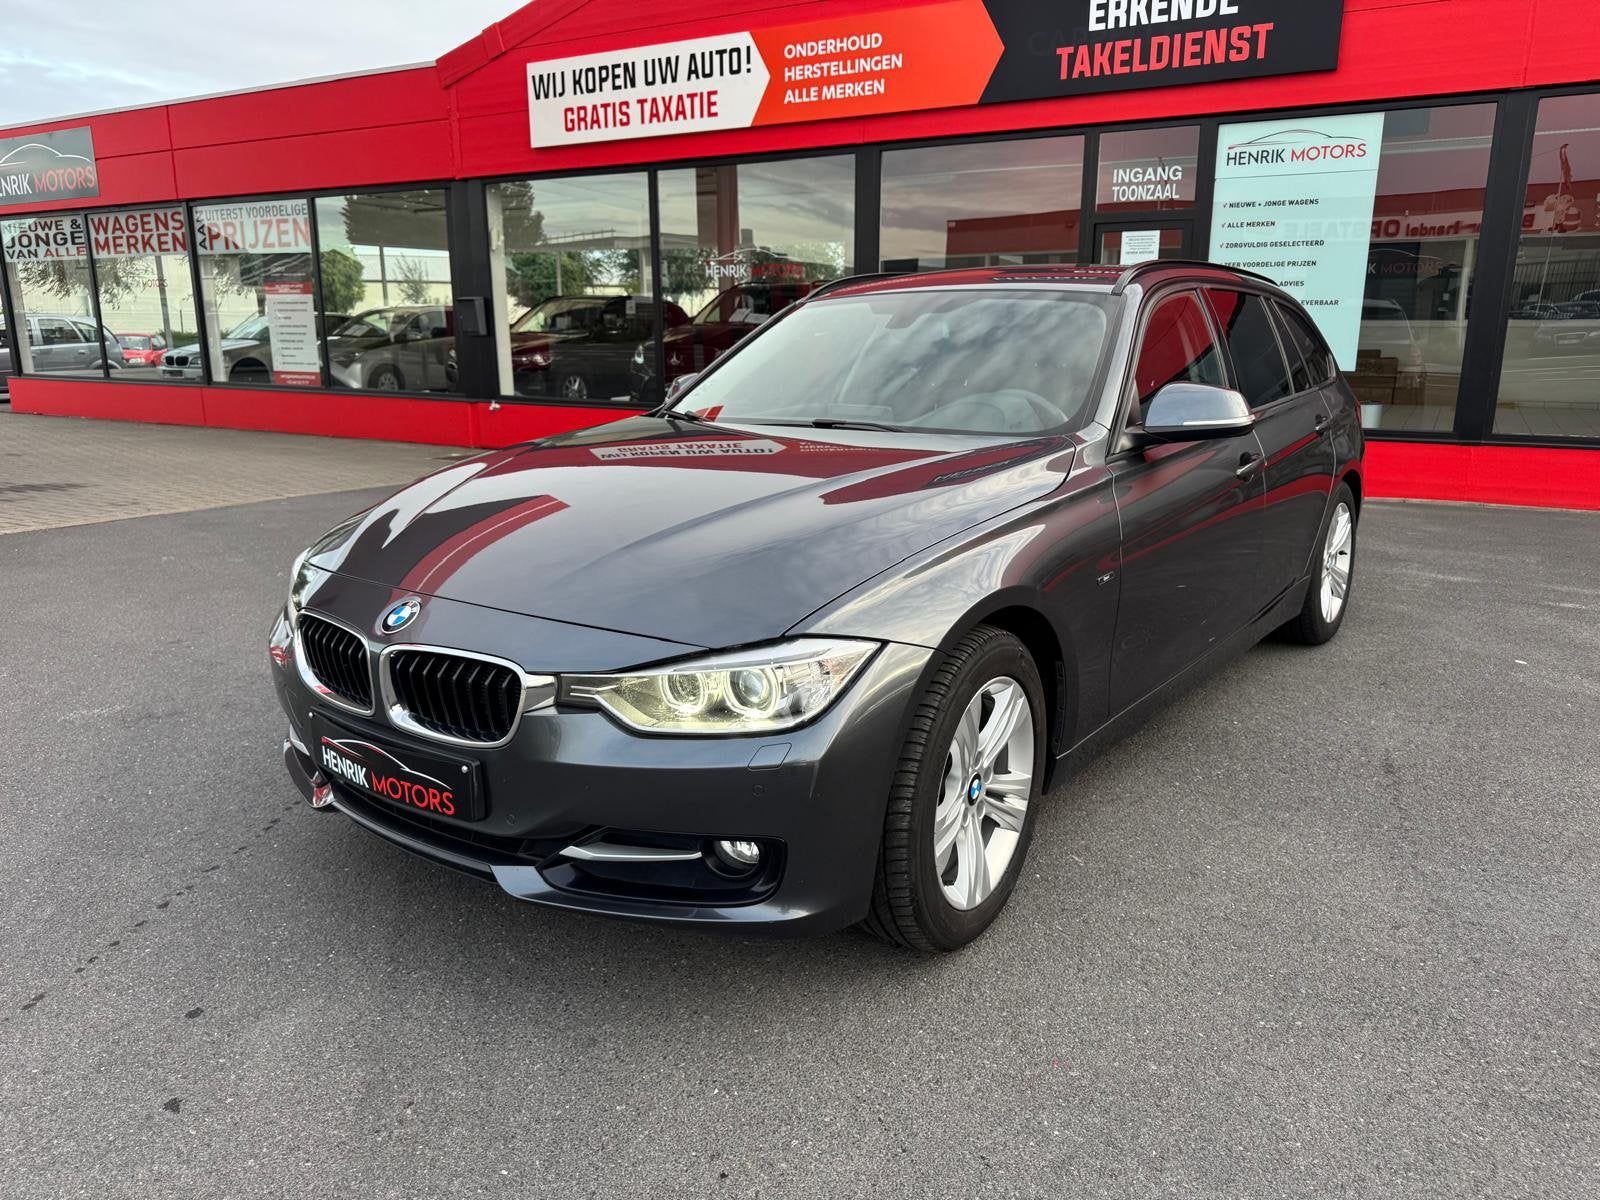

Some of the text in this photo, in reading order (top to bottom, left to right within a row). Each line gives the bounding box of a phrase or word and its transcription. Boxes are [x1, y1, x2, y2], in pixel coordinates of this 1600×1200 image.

[783, 33, 883, 59] ONDERHOUD
[1056, 23, 1274, 80] TAKELDIENST
[532, 45, 752, 100] WIJ KOPEN UW AUTO!
[784, 53, 903, 82] HERSTELLINGEN
[784, 79, 885, 105] ALLE MERKEN
[564, 90, 719, 132] GRATIS TAXATIE
[1226, 143, 1367, 166] HENRIK MOTORS
[0, 166, 95, 196] NRIK MOTORS
[1113, 165, 1183, 183] INGANG
[1112, 183, 1180, 202] TOONZAAL
[1229, 201, 1257, 209] NIEUWE
[1288, 198, 1319, 206] WAGENS
[89, 211, 184, 235] WAGENS
[204, 203, 308, 221] UITERST VOORDELIGE
[3, 218, 81, 234] NIEUWE &
[207, 217, 311, 251] PRIJZEN
[1227, 220, 1276, 229] ALLE MERKEN
[5, 230, 85, 249] JONGE
[95, 230, 188, 255] MERKEN
[1225, 239, 1325, 249] ZORGVULDIG GESELECTEERD
[5, 246, 87, 259] VAN ALLE
[1242, 260, 1285, 268] VOORDELIGE
[1287, 259, 1317, 267] PRIJZEN
[705, 263, 804, 278] HENRIK MOTORS
[321, 745, 456, 816] HENRIK MOTORS
